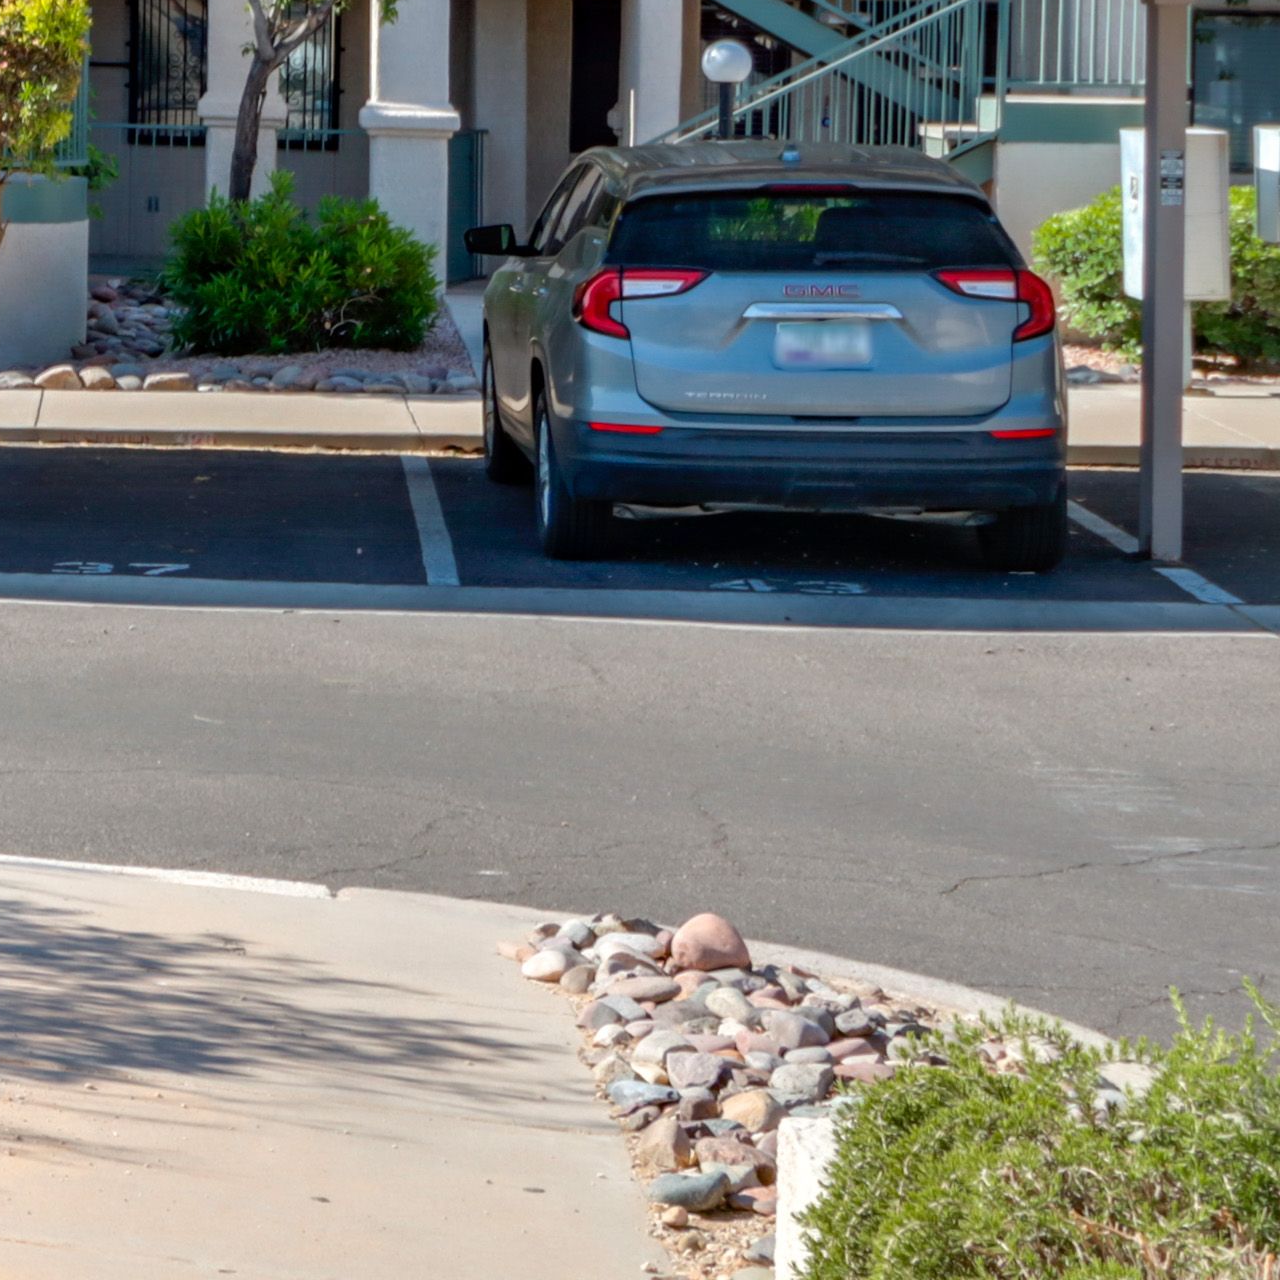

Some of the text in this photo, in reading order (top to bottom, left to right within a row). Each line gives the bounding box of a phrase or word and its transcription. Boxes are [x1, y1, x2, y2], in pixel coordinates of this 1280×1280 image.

[783, 284, 860, 298] GMC
[51, 561, 190, 576] 37
[709, 578, 870, 595] 43
